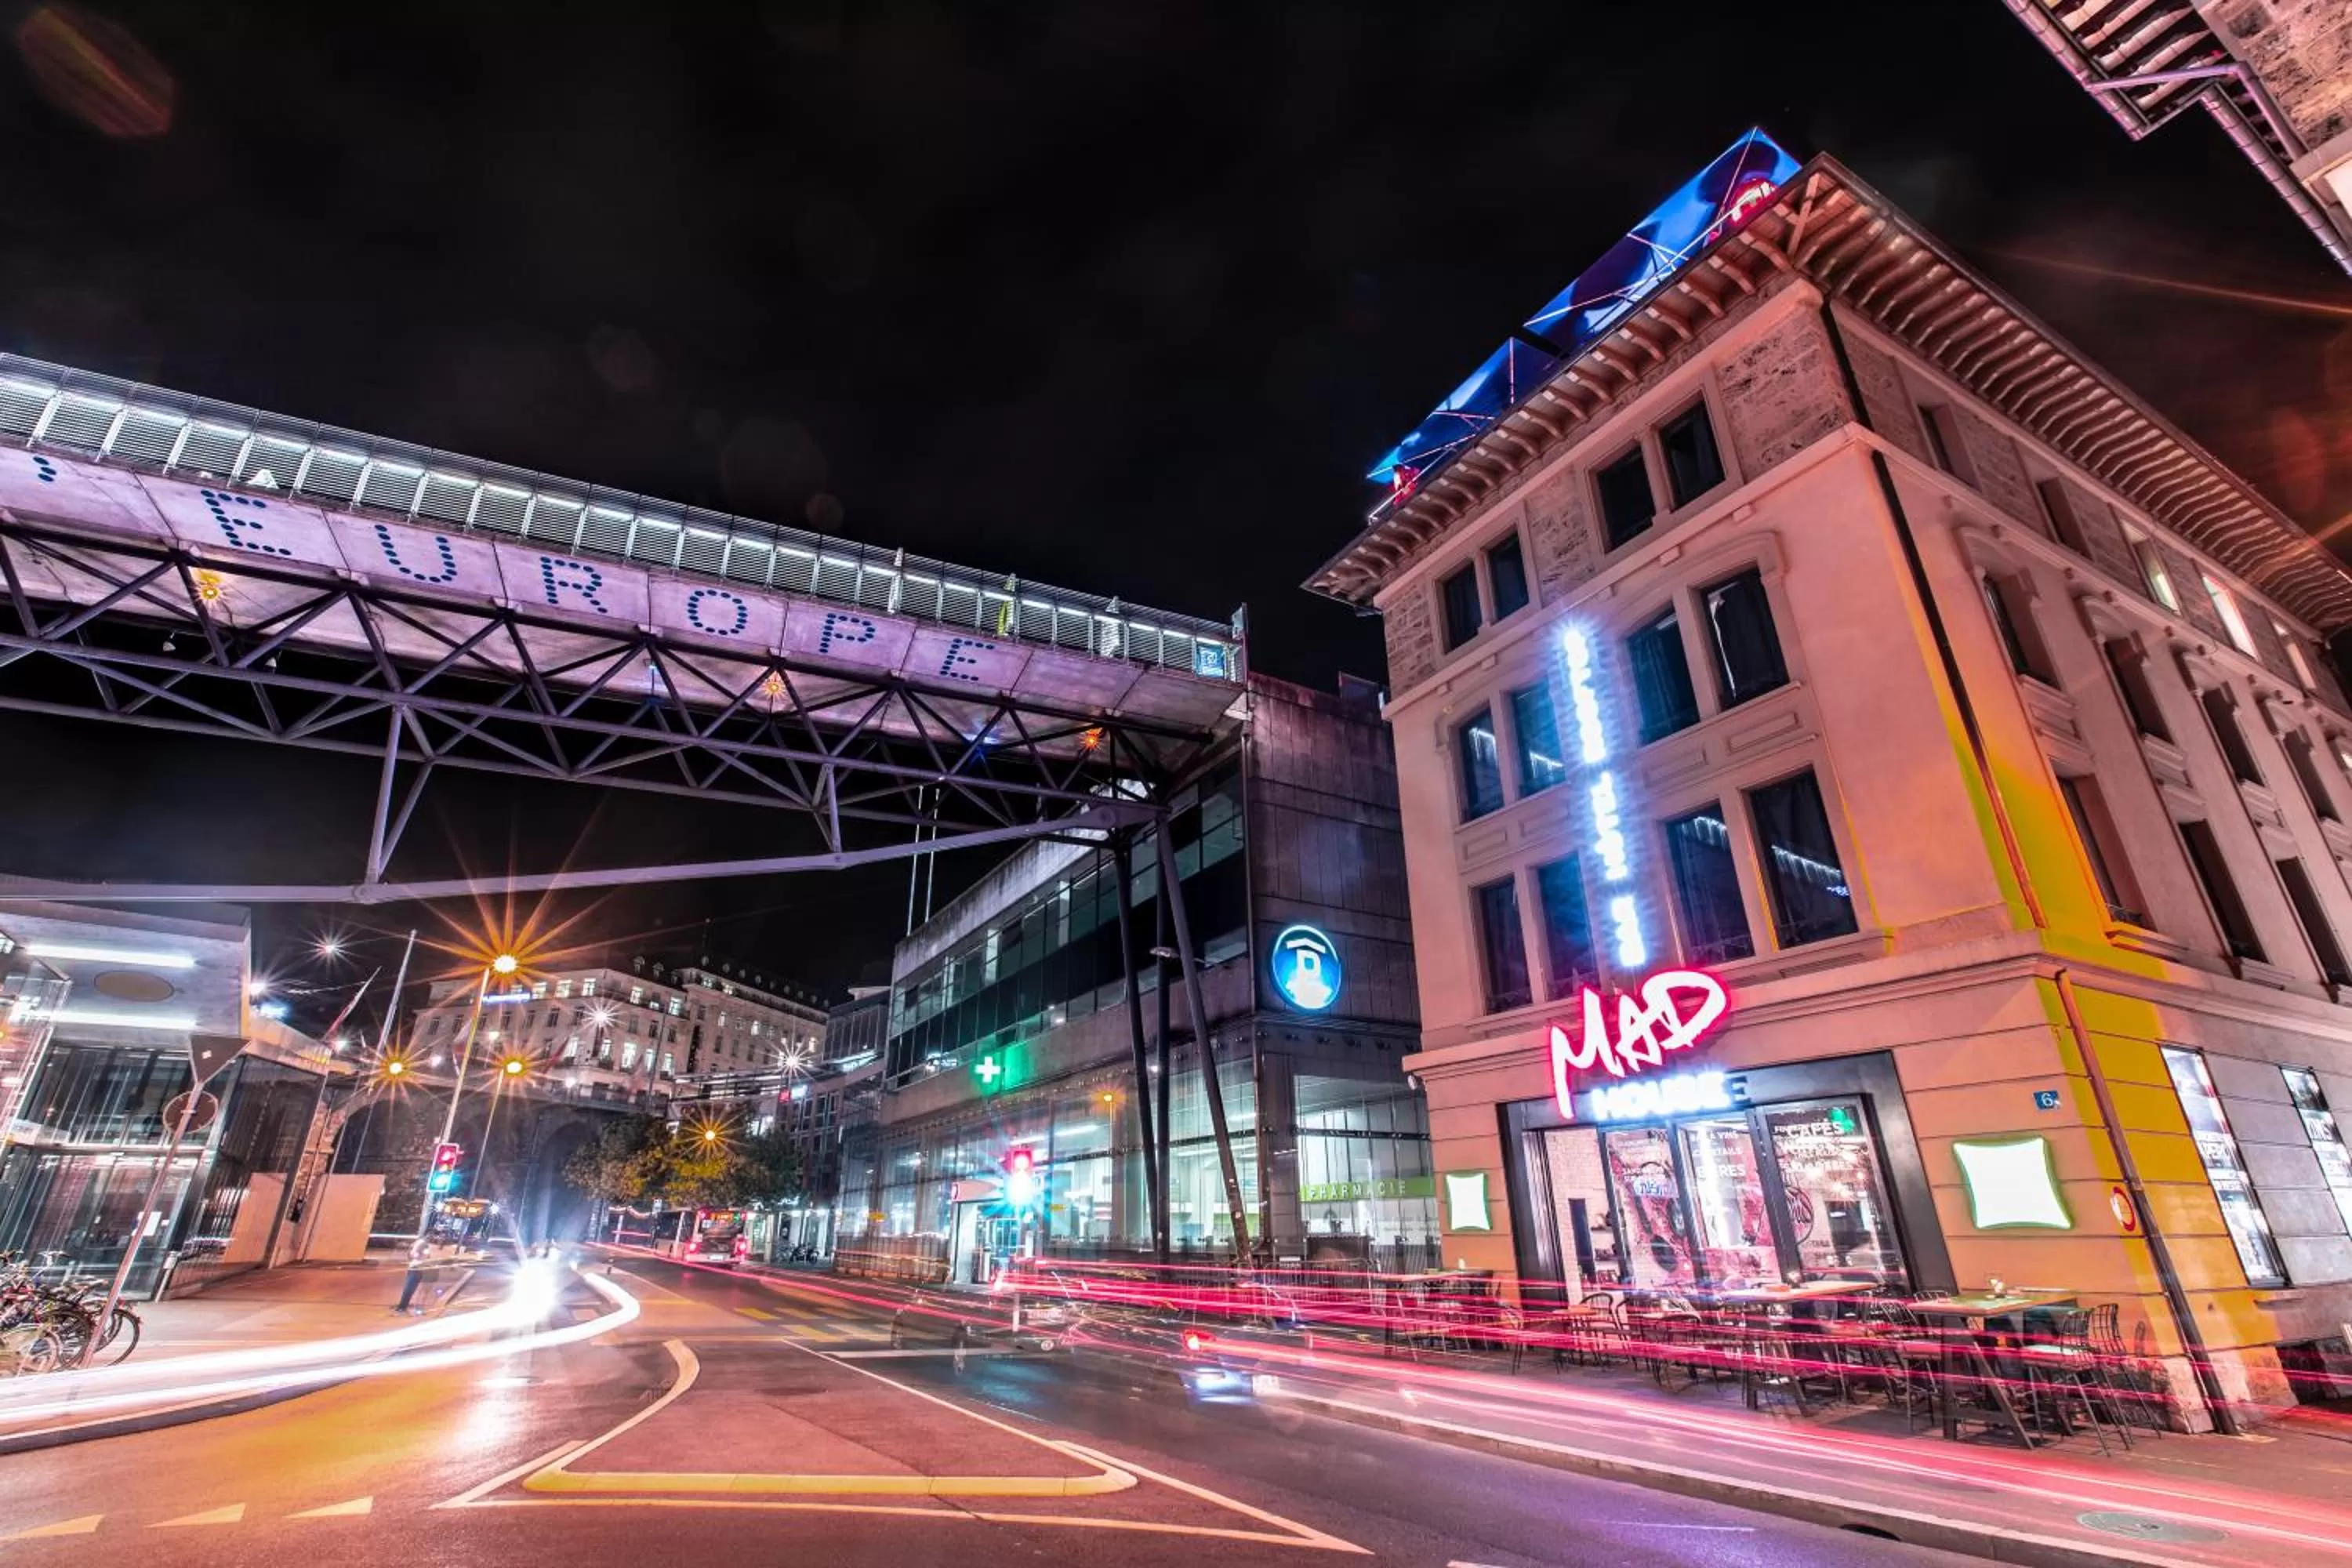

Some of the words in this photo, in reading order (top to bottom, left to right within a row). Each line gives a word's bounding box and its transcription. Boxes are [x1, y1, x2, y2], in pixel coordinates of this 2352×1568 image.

[1551, 971, 1726, 1120] MAD
[2042, 1092, 2053, 1107] 6
[1696, 1163, 1747, 1179] BRES
[1309, 1181, 1406, 1201] PHARMACIE
